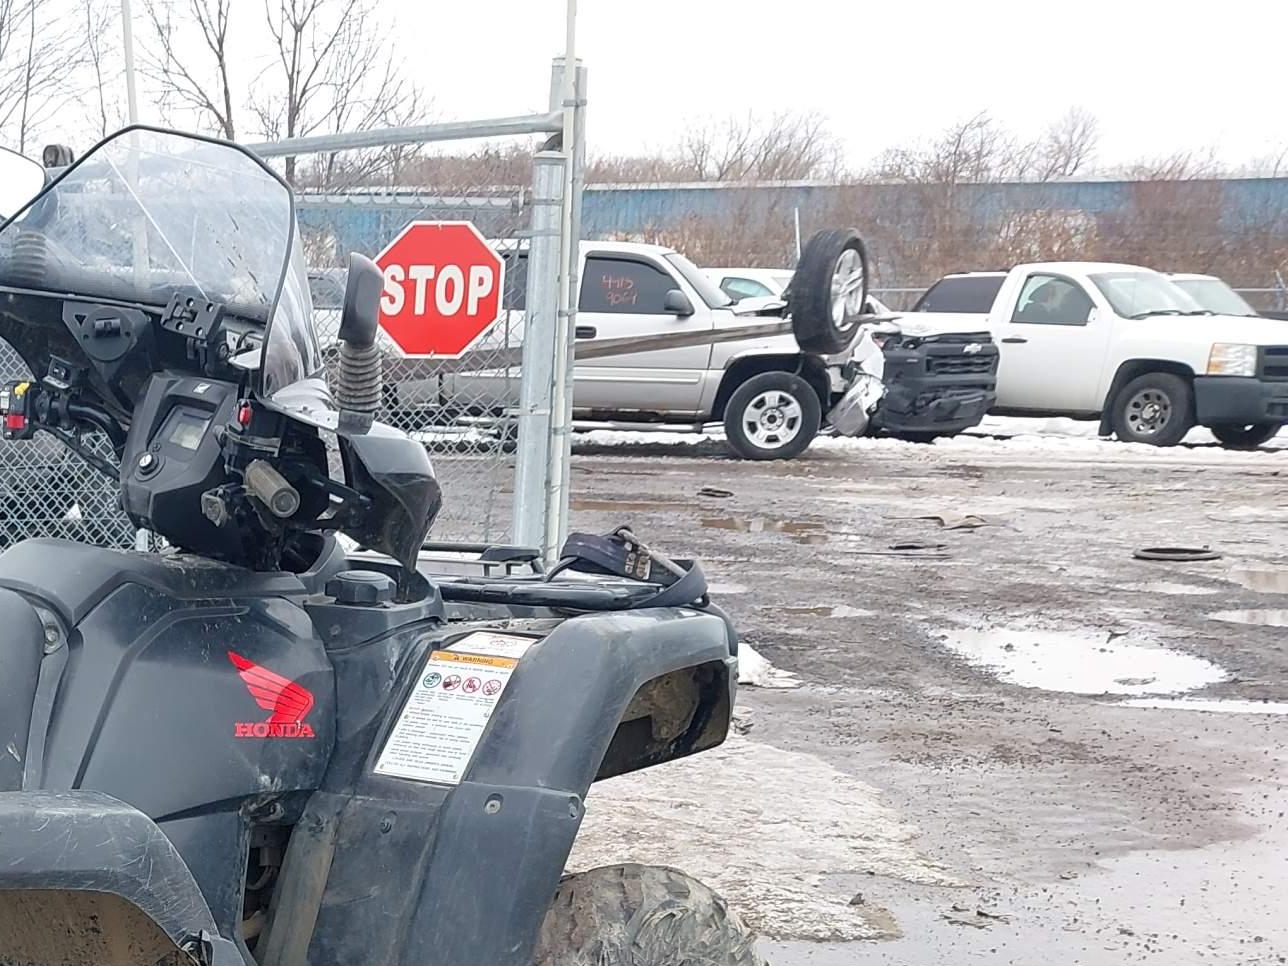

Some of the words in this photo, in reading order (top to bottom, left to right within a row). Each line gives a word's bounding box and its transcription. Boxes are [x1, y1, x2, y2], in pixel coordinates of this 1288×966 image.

[380, 264, 493, 316] STOP
[463, 656, 494, 665] WARNING
[234, 722, 315, 737] HONDA
